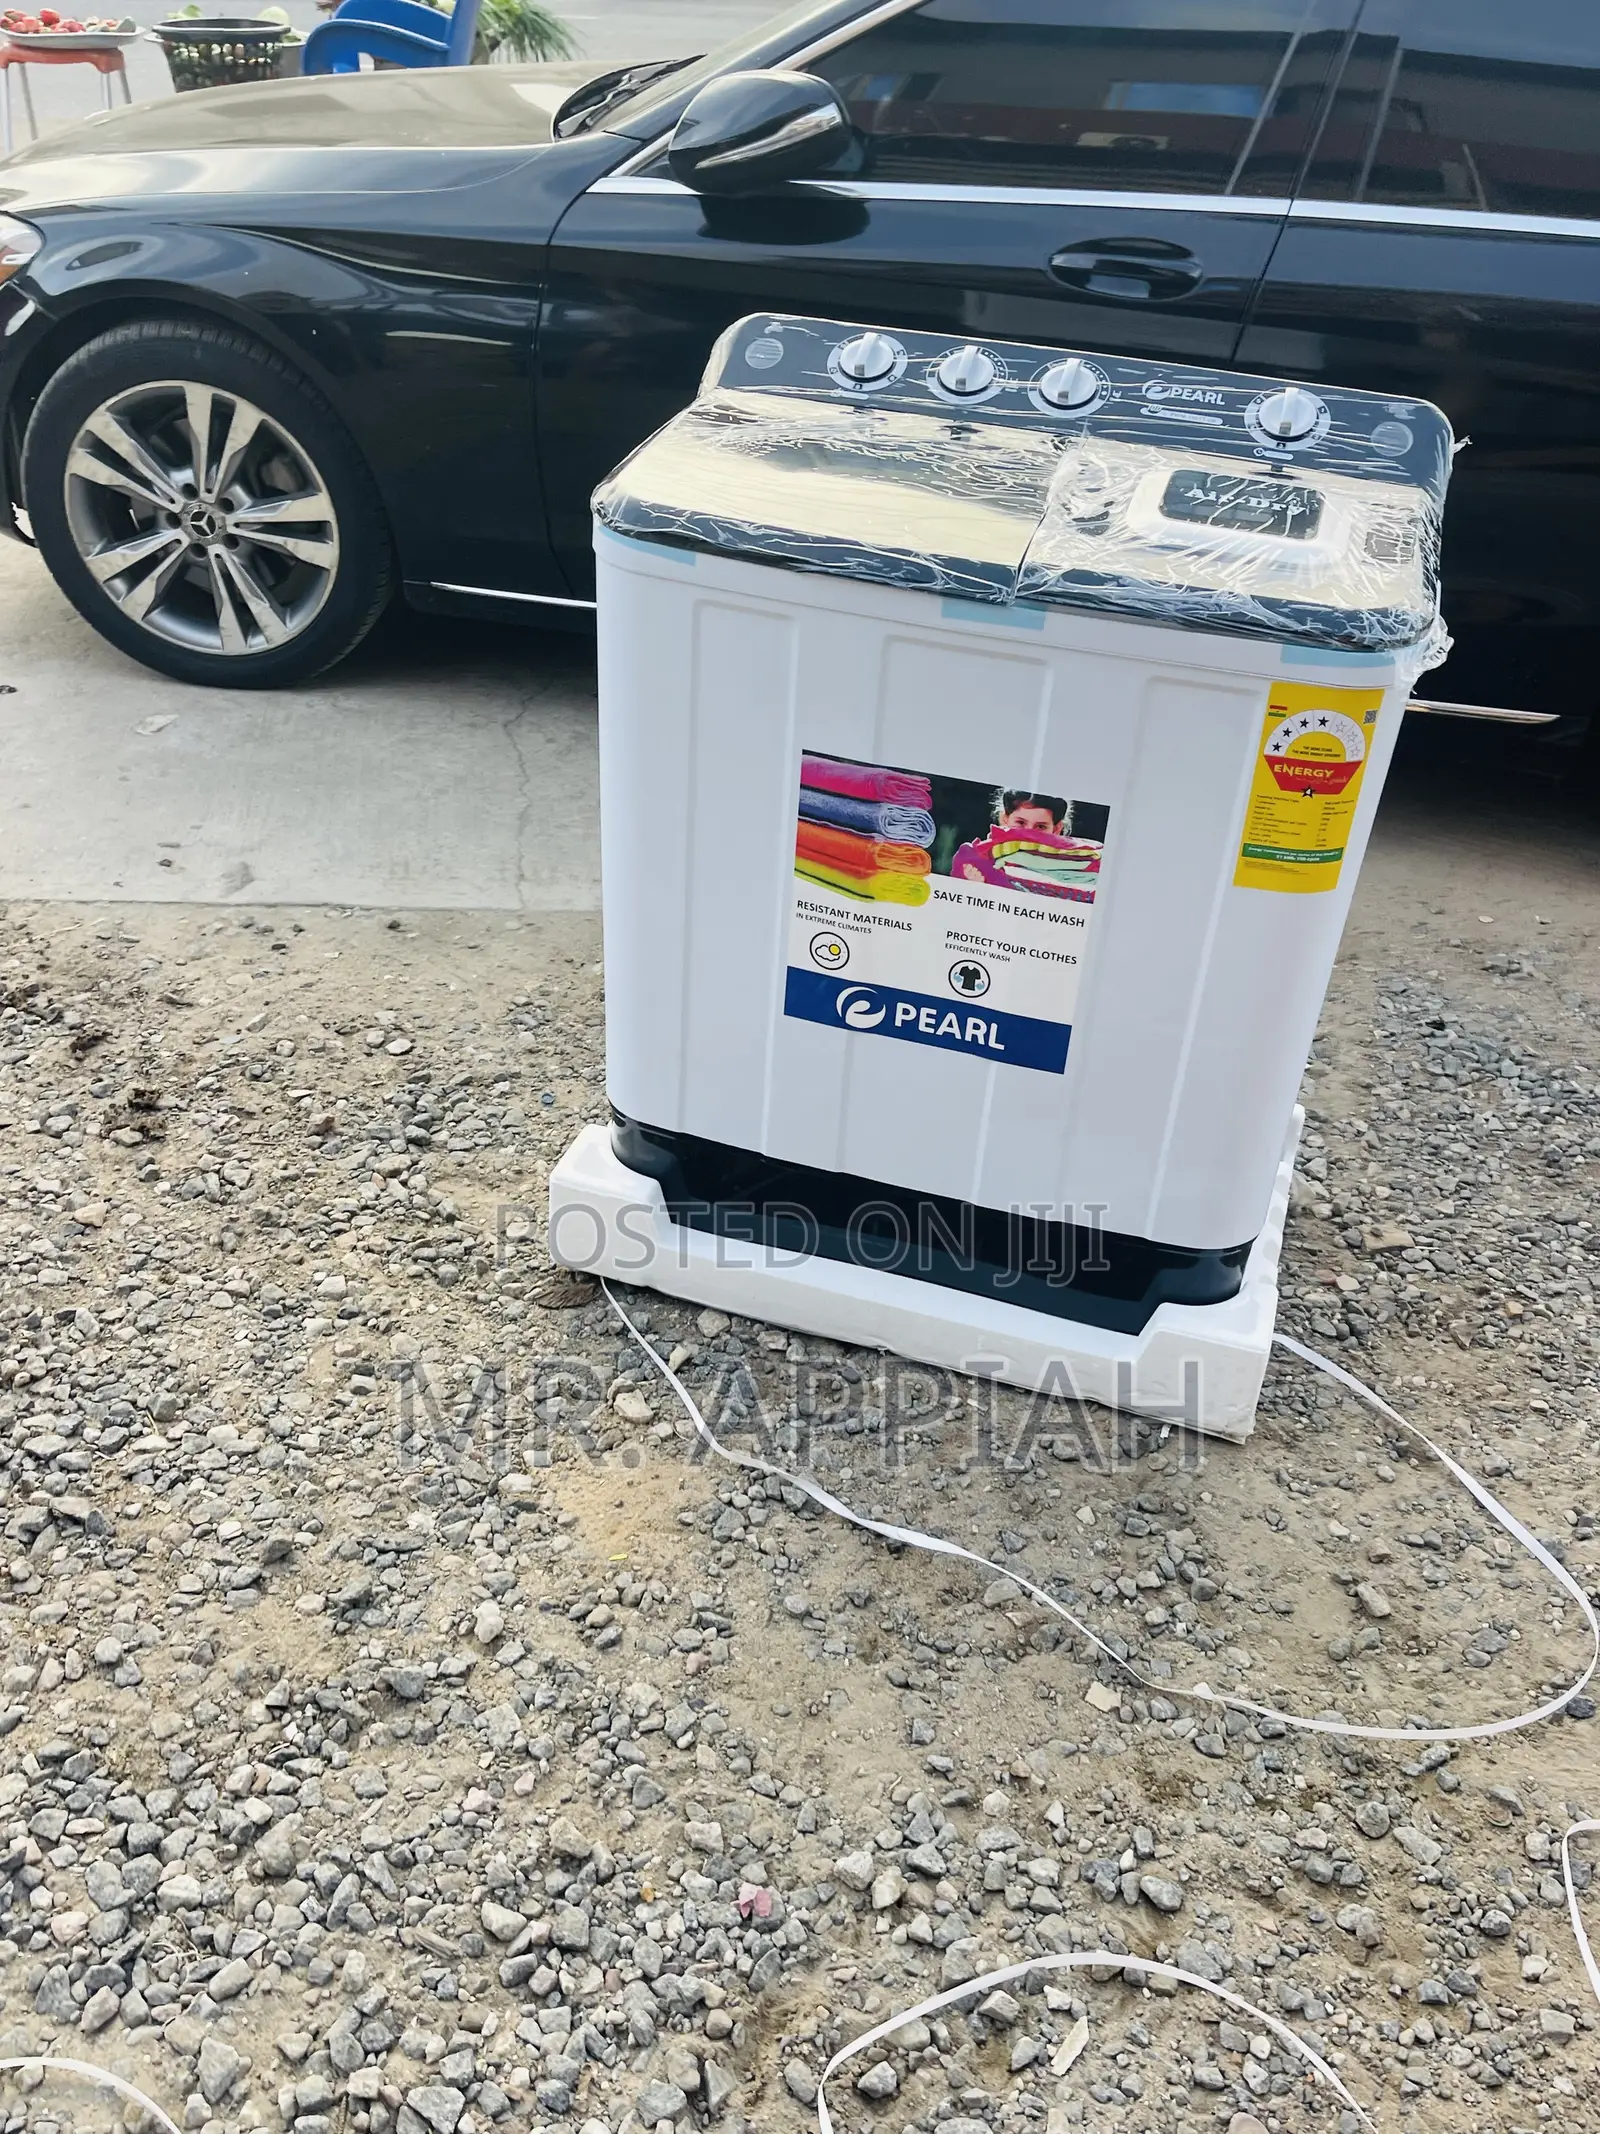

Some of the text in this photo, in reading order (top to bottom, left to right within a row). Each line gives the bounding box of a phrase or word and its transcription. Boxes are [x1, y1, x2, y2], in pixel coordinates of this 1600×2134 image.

[1170, 386, 1226, 406] PEARL
[1273, 763, 1334, 778] ENERGY
[797, 900, 913, 932] RESISTANT MATERIALS
[933, 890, 1085, 928] SAVE TIME IN EACH WASH
[805, 914, 836, 927] EXTREME
[838, 922, 872, 934] CLIMATES
[944, 943, 1011, 963] EFFICIENTLY WASH
[946, 930, 1077, 965] PROTECT YOUR CLOTHES
[894, 1002, 1005, 1051] PEARL
